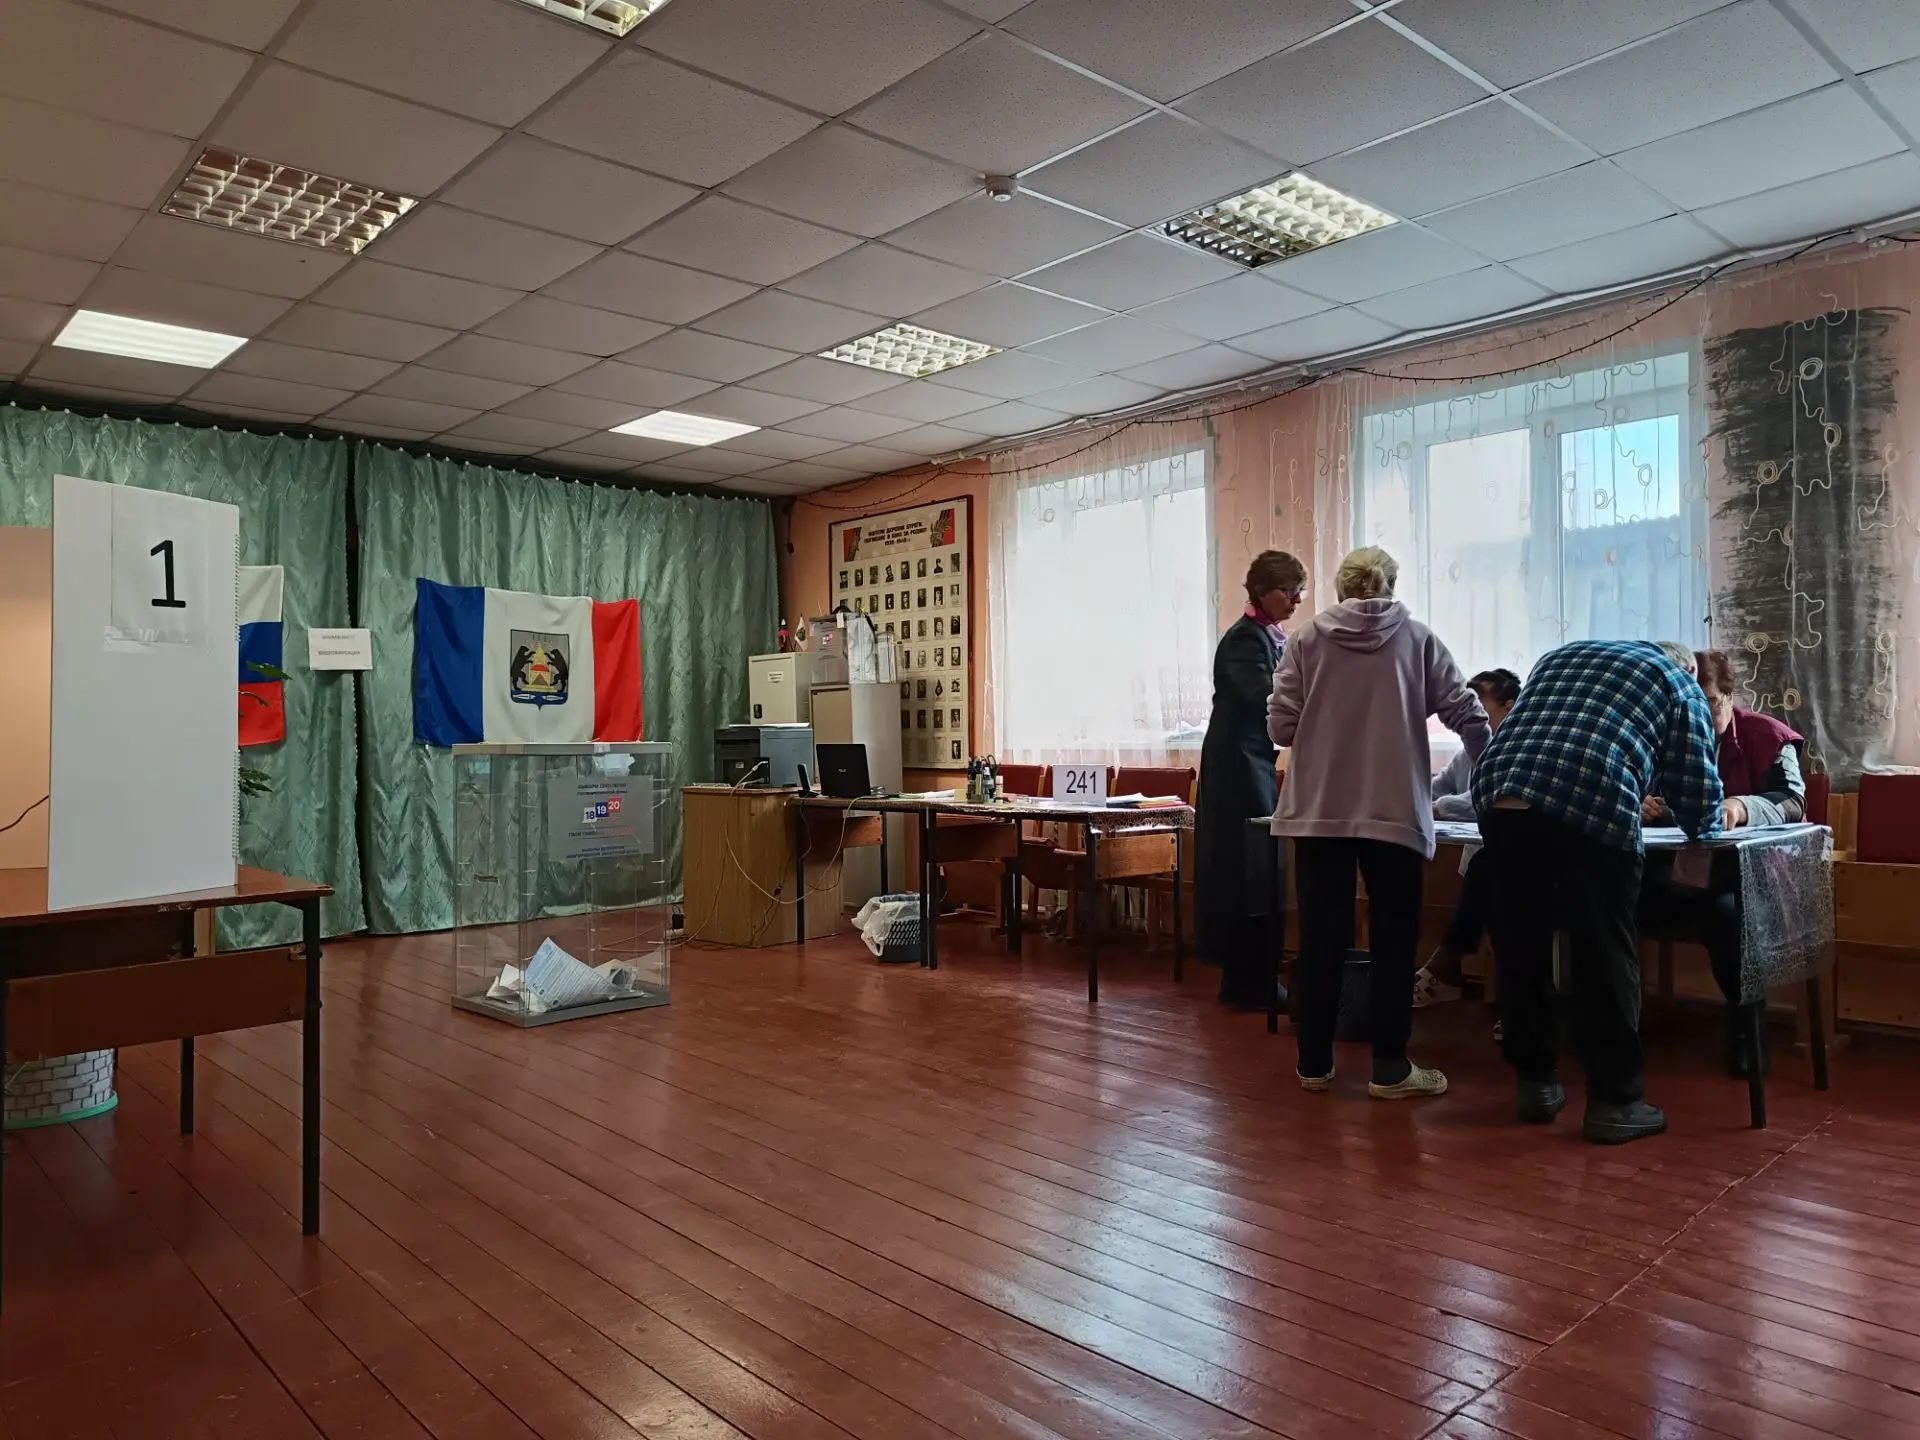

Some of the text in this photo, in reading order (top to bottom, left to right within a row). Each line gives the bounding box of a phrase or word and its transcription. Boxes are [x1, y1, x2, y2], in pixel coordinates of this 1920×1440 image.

[150, 539, 187, 609] 1
[1065, 769, 1097, 795] 241
[585, 801, 620, 820] 18 19 20
